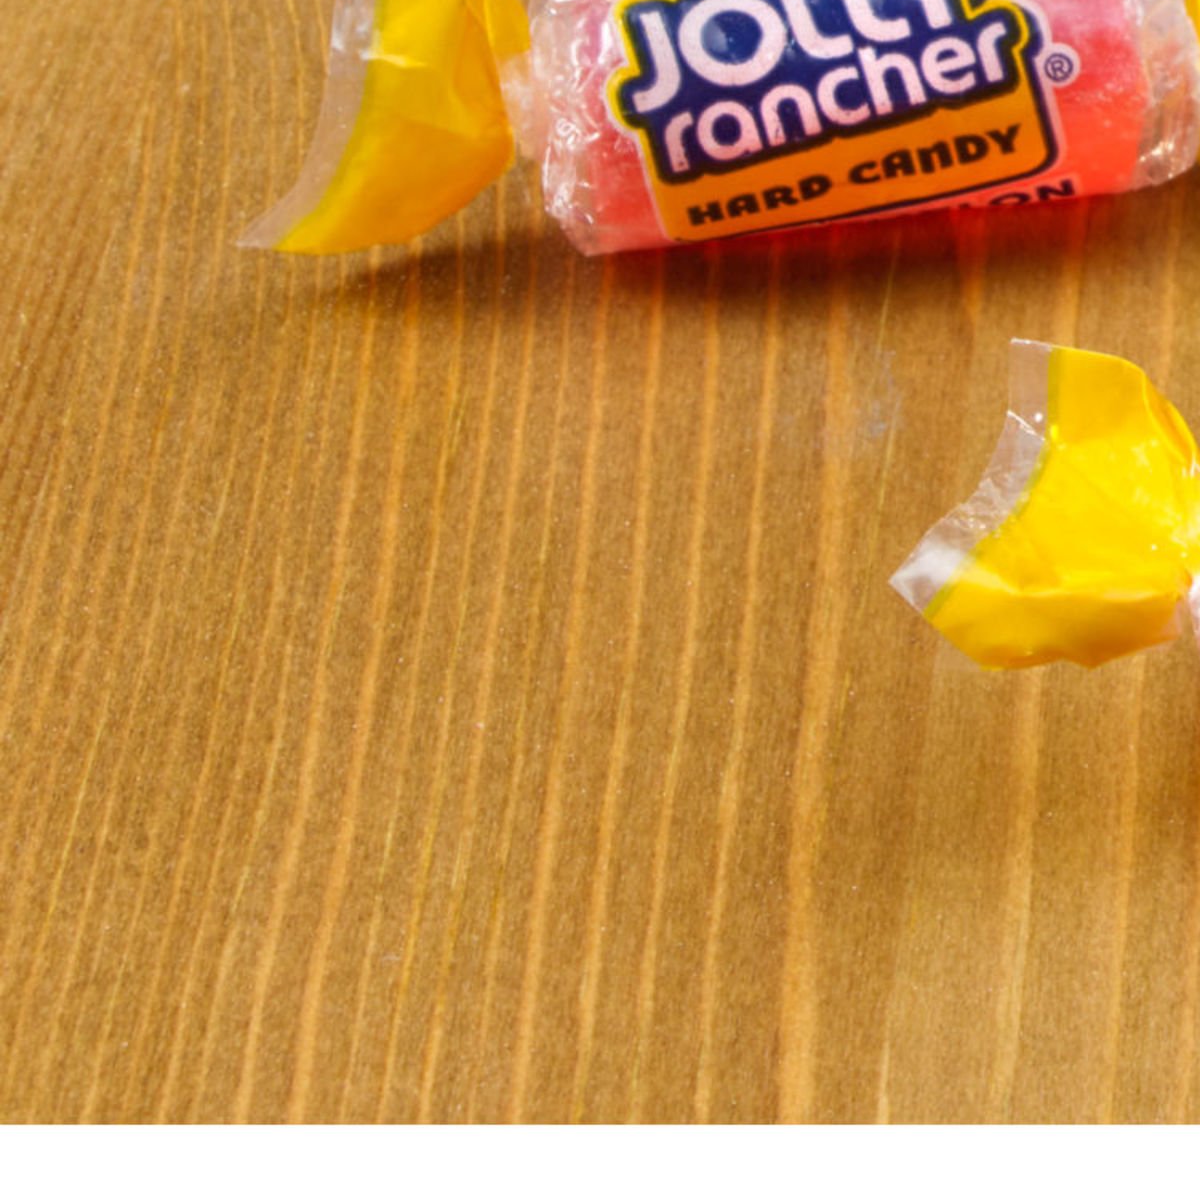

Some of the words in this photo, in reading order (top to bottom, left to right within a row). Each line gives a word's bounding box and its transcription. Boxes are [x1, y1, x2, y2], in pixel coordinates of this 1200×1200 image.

[662, 21, 1008, 174] rancher
[686, 174, 834, 227] HARD
[848, 122, 1022, 185] CANDY
